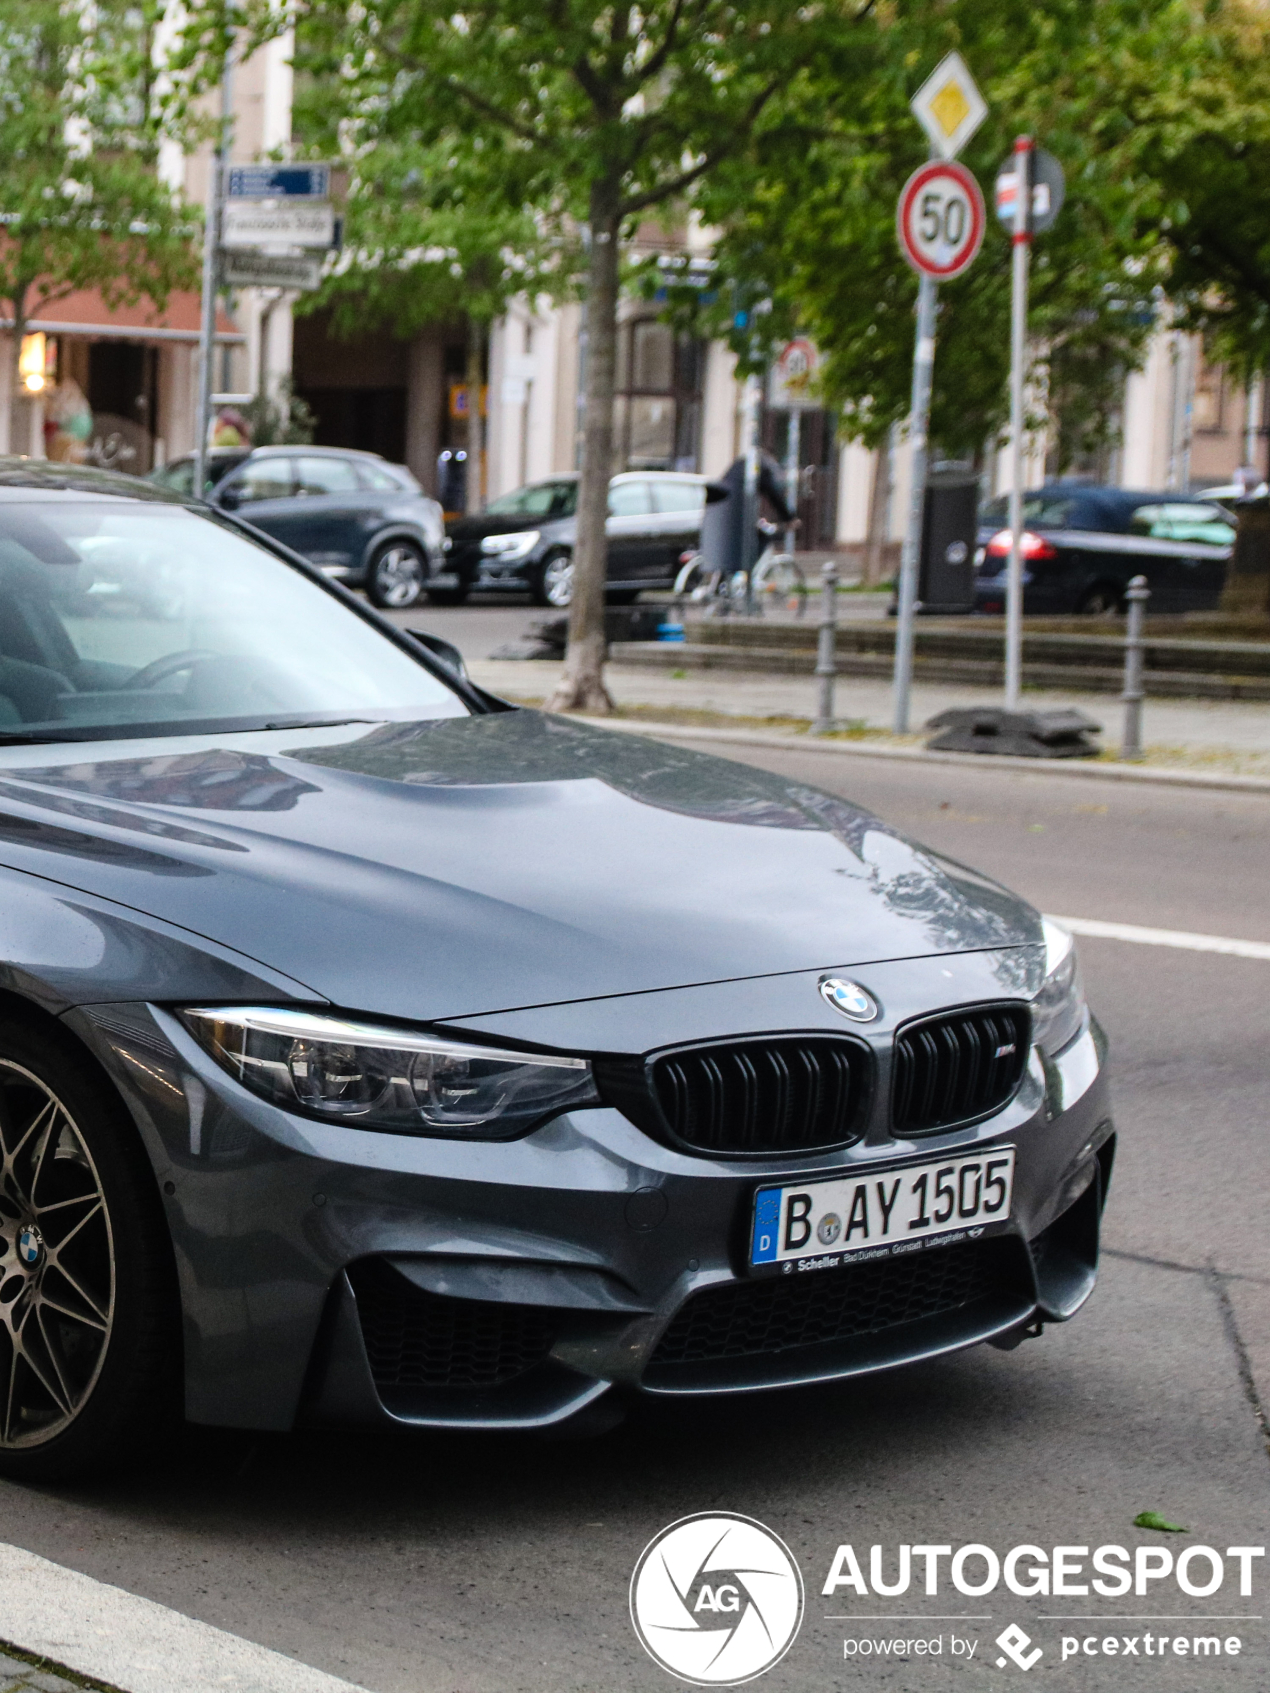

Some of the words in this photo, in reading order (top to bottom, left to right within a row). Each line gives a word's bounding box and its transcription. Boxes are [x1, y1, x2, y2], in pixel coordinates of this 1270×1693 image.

[920, 191, 964, 246] 50
[783, 1193, 812, 1251] B
[844, 1177, 902, 1242] AY
[908, 1158, 1009, 1230] 1505
[759, 1234, 771, 1252] D
[797, 1256, 840, 1272] Scheller
